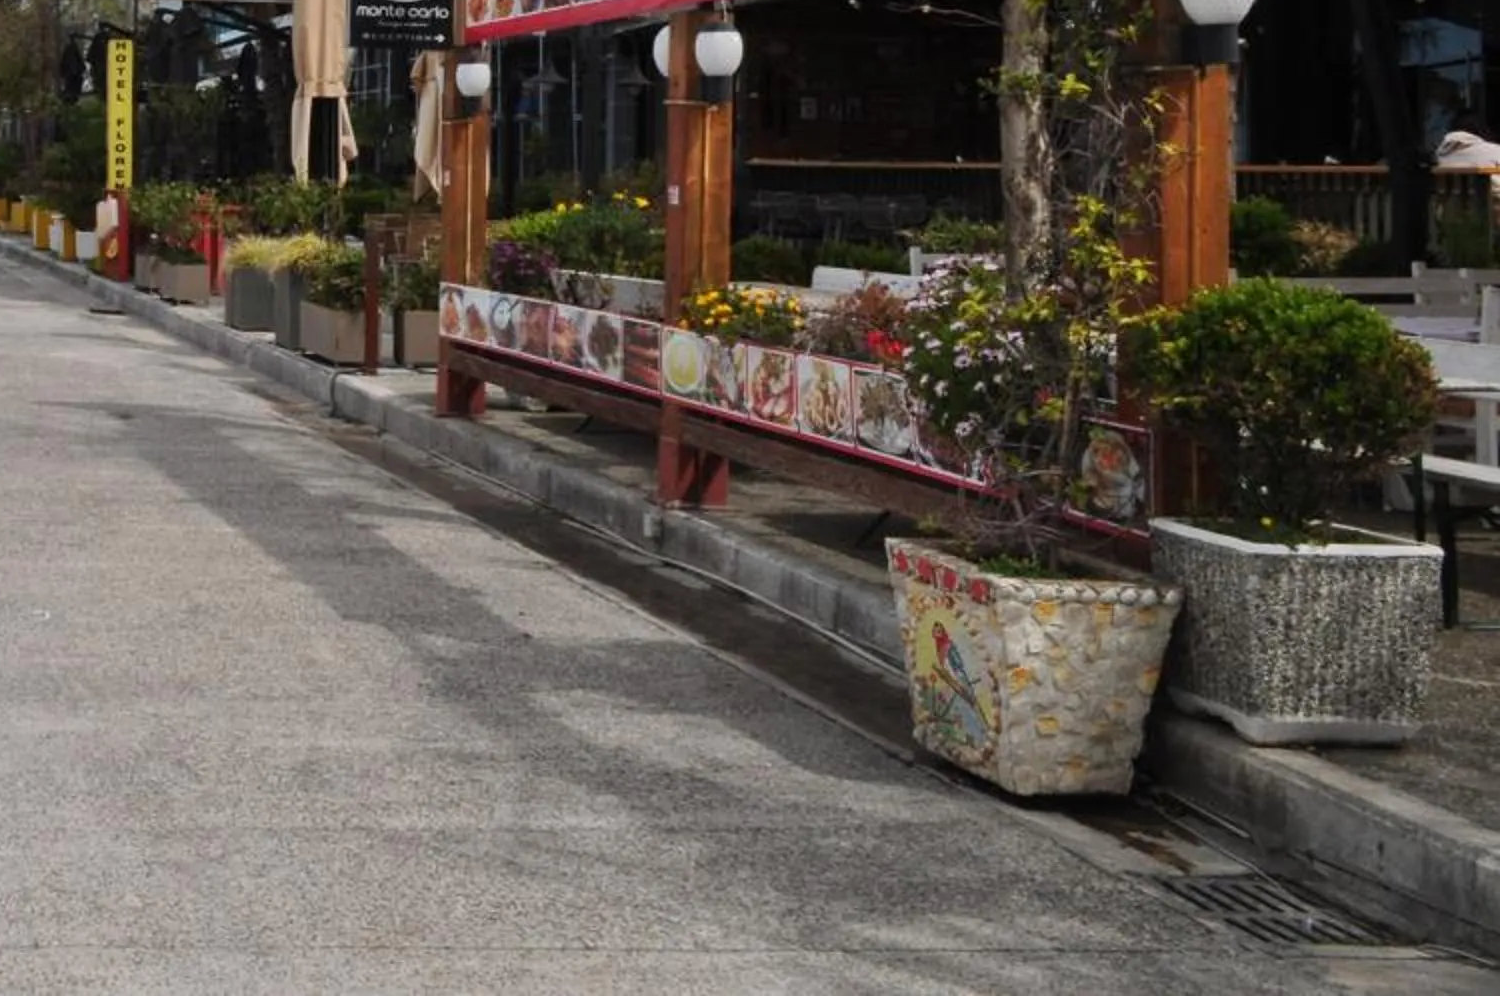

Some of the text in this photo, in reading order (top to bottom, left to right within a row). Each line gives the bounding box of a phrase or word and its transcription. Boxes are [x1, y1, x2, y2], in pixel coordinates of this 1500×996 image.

[356, 5, 449, 19] monte carlo
[115, 42, 127, 102] HOTEL
